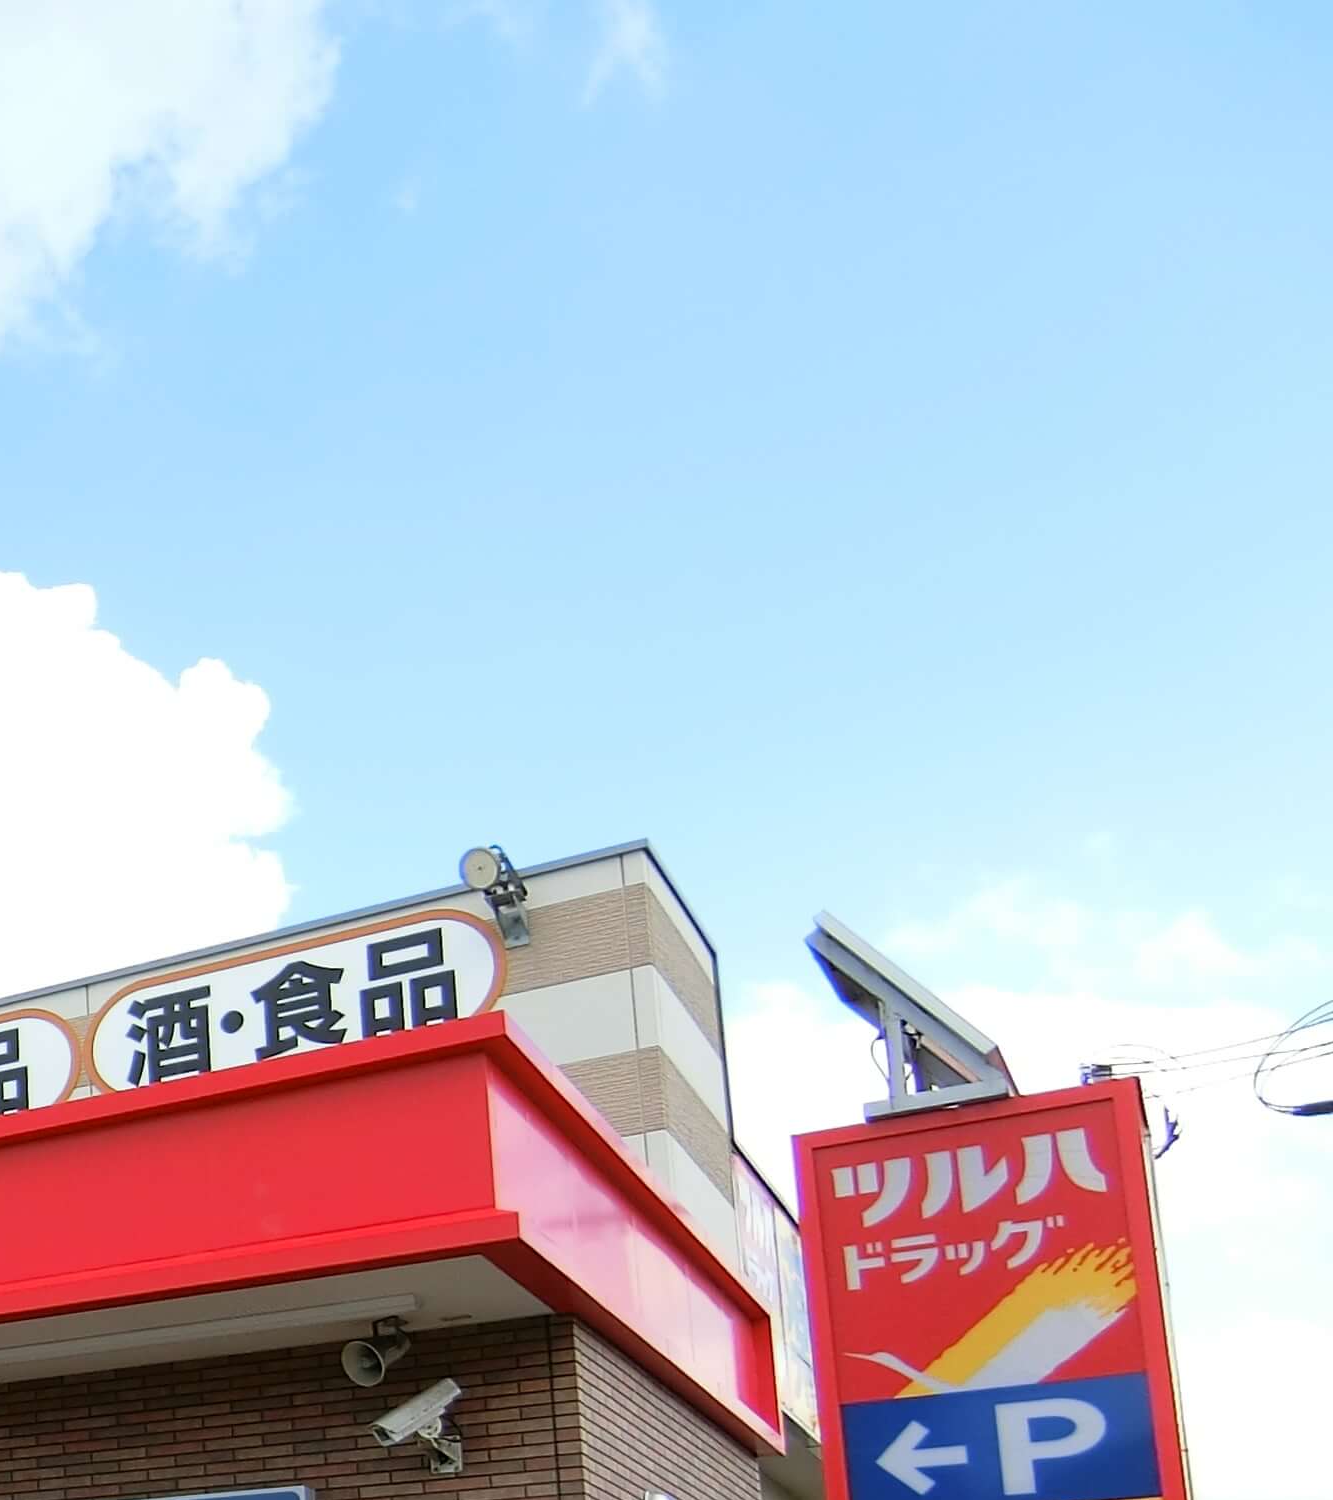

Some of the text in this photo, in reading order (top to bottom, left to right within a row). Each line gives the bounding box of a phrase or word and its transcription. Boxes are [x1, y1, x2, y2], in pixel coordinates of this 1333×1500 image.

[126, 927, 461, 1086] 酒・食品
[831, 1128, 1108, 1227] ツルハ
[842, 1215, 1065, 1291] ドラッグ
[994, 1398, 1107, 1496] P
